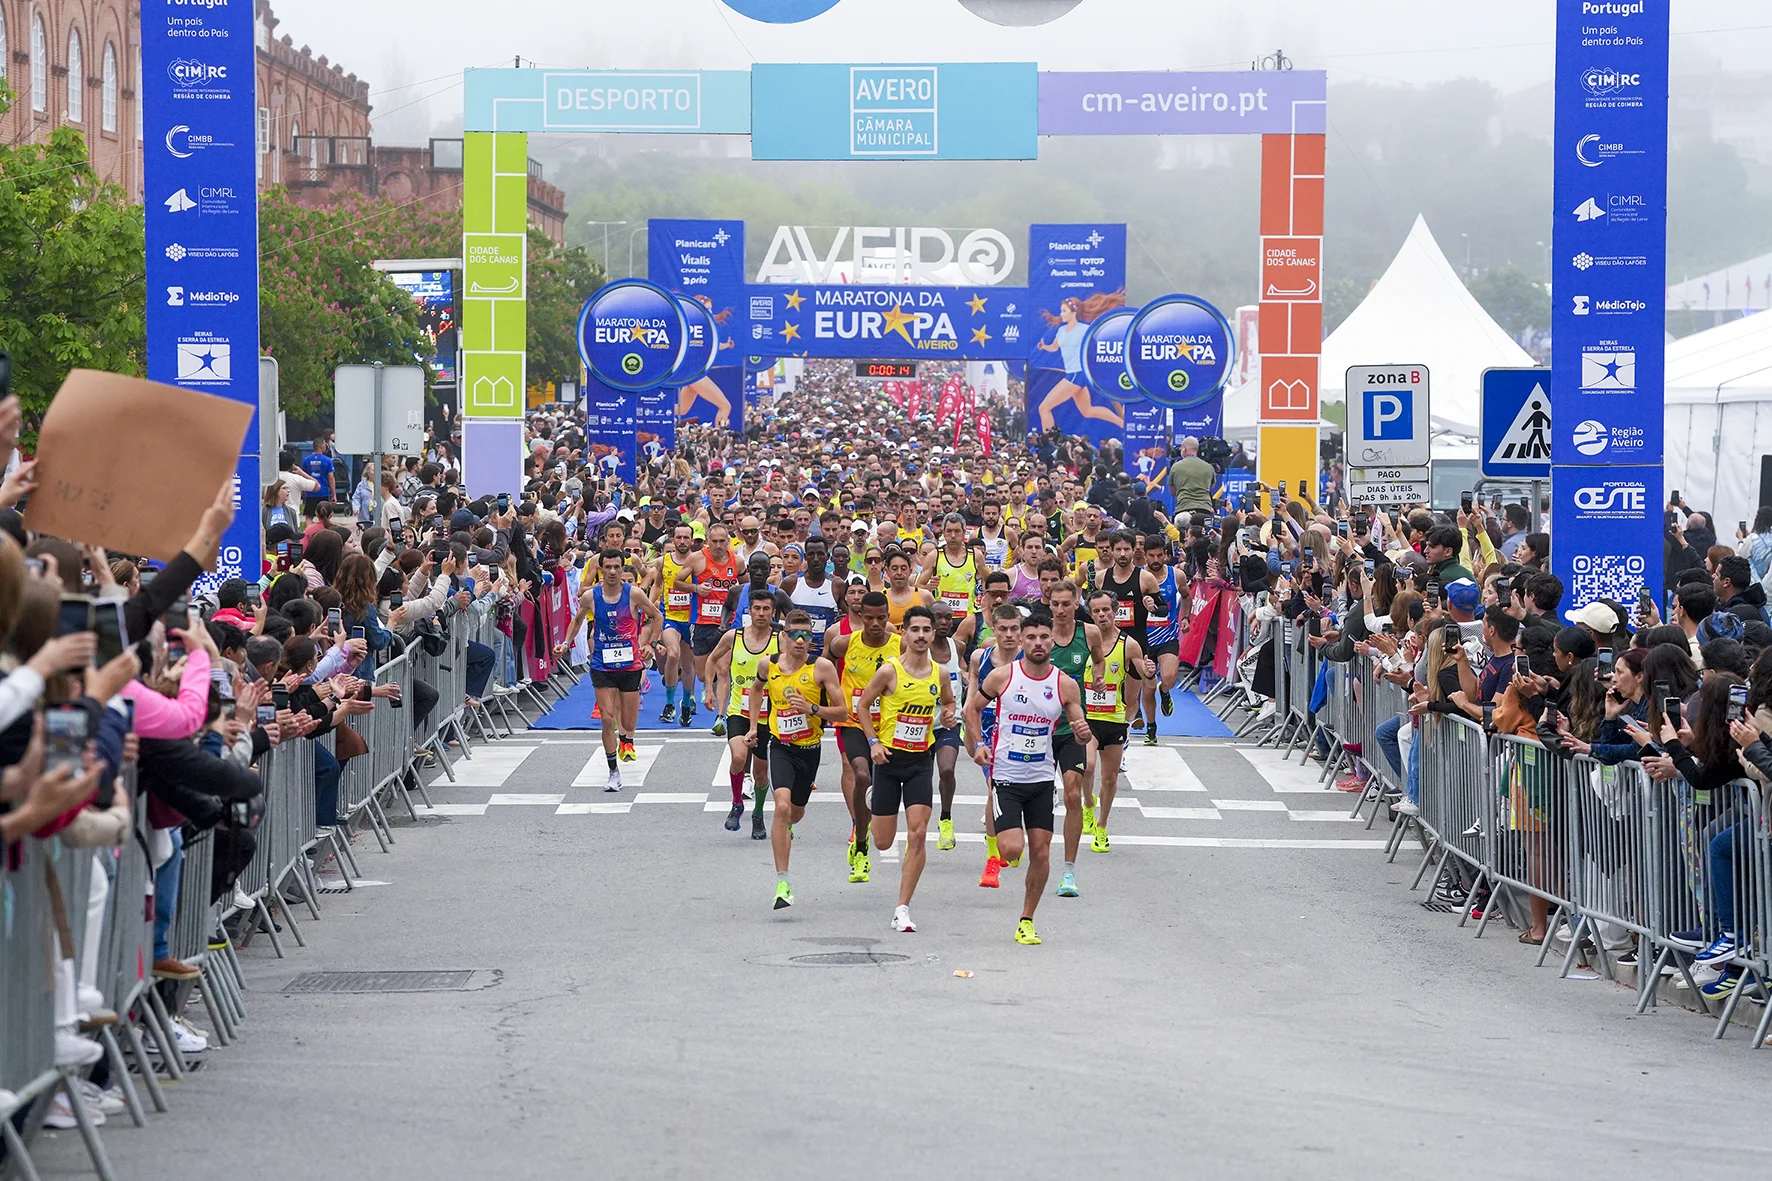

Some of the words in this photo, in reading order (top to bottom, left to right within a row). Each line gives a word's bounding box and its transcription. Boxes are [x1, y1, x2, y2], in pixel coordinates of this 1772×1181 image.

[1582, 1, 1644, 17] Portugal
[167, 17, 183, 25] Um
[184, 17, 203, 27] país
[168, 28, 197, 37] dentro
[199, 28, 210, 37] do
[211, 28, 229, 38] País
[1582, 26, 1598, 35] Um
[1600, 26, 1618, 36] país
[1582, 37, 1611, 46] dentro
[1613, 37, 1624, 46] do
[1626, 37, 1643, 45] País
[856, 78, 932, 100] AVEIRO
[557, 88, 691, 111] DESPORTO
[1082, 86, 1268, 117] cm-aveiro.pt
[856, 133, 931, 145] MUNICIPAL
[201, 188, 237, 198] CIMRL
[1610, 196, 1646, 206] CIMRL
[675, 240, 717, 248] Planicare
[1049, 242, 1090, 250] Planicare
[489, 256, 518, 264] CANAIS
[681, 253, 710, 265] Vitalis
[755, 225, 1015, 286] AVEIRO
[1286, 258, 1316, 266] CANAIS
[690, 276, 708, 284] prio
[190, 291, 239, 303] MédioTejo
[815, 290, 915, 306] MARATONA
[920, 292, 945, 307] DA
[1596, 300, 1645, 312] MédioTejo
[596, 318, 650, 327] MARATONA
[652, 319, 667, 327] DA
[1142, 335, 1196, 343] MARATONA
[1198, 335, 1212, 343] DA
[917, 340, 958, 350] AVEIRO
[868, 365, 910, 376] 0:00:14
[1368, 373, 1407, 384] zona
[1411, 371, 1421, 384] B
[1373, 395, 1403, 436] P
[1611, 427, 1643, 438] Região
[1611, 439, 1644, 447] Aveiro
[784, 717, 803, 728] 7755
[905, 726, 923, 736] 7957
[1025, 739, 1036, 748] 25
